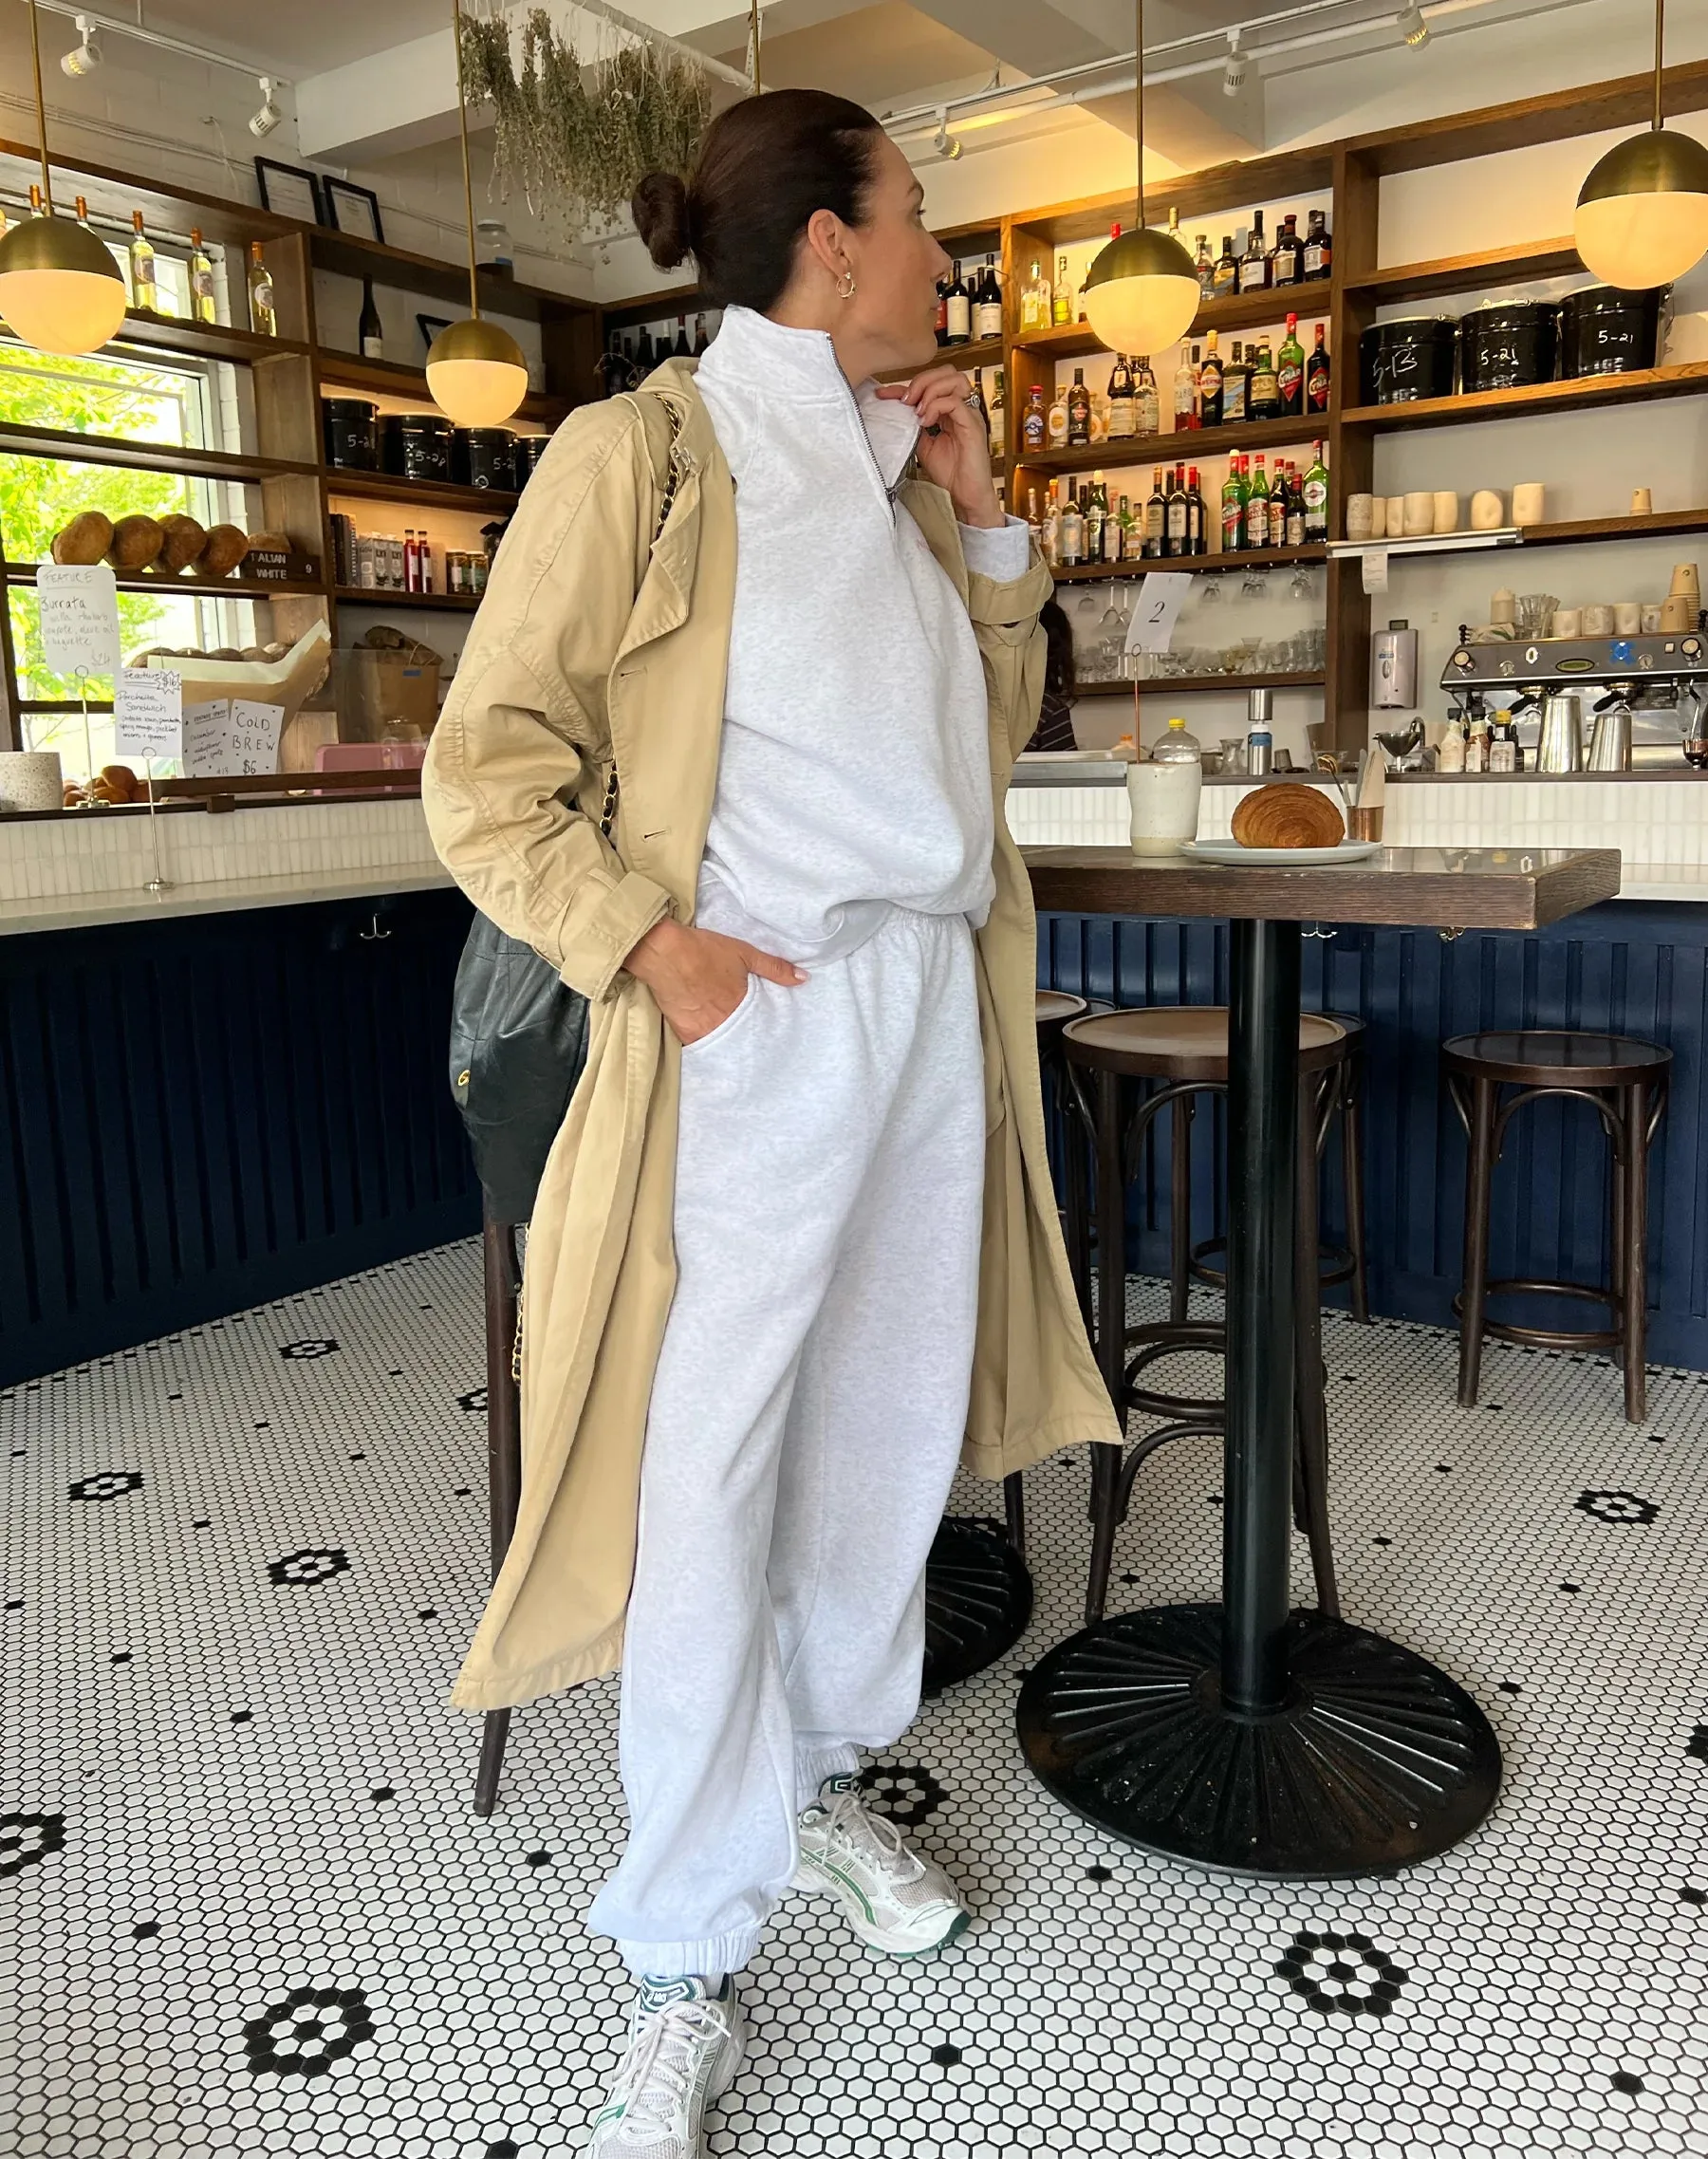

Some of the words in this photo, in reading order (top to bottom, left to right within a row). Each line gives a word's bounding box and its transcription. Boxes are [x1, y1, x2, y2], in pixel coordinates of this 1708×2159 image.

[1598, 329, 1635, 344] 5-21
[256, 568, 288, 580] WHITE
[305, 564, 312, 574] 9
[1148, 601, 1165, 623] 2
[162, 676, 176, 687] $16
[125, 701, 167, 713] Sandwich
[232, 735, 275, 751] BREW
[243, 758, 257, 774] $6
